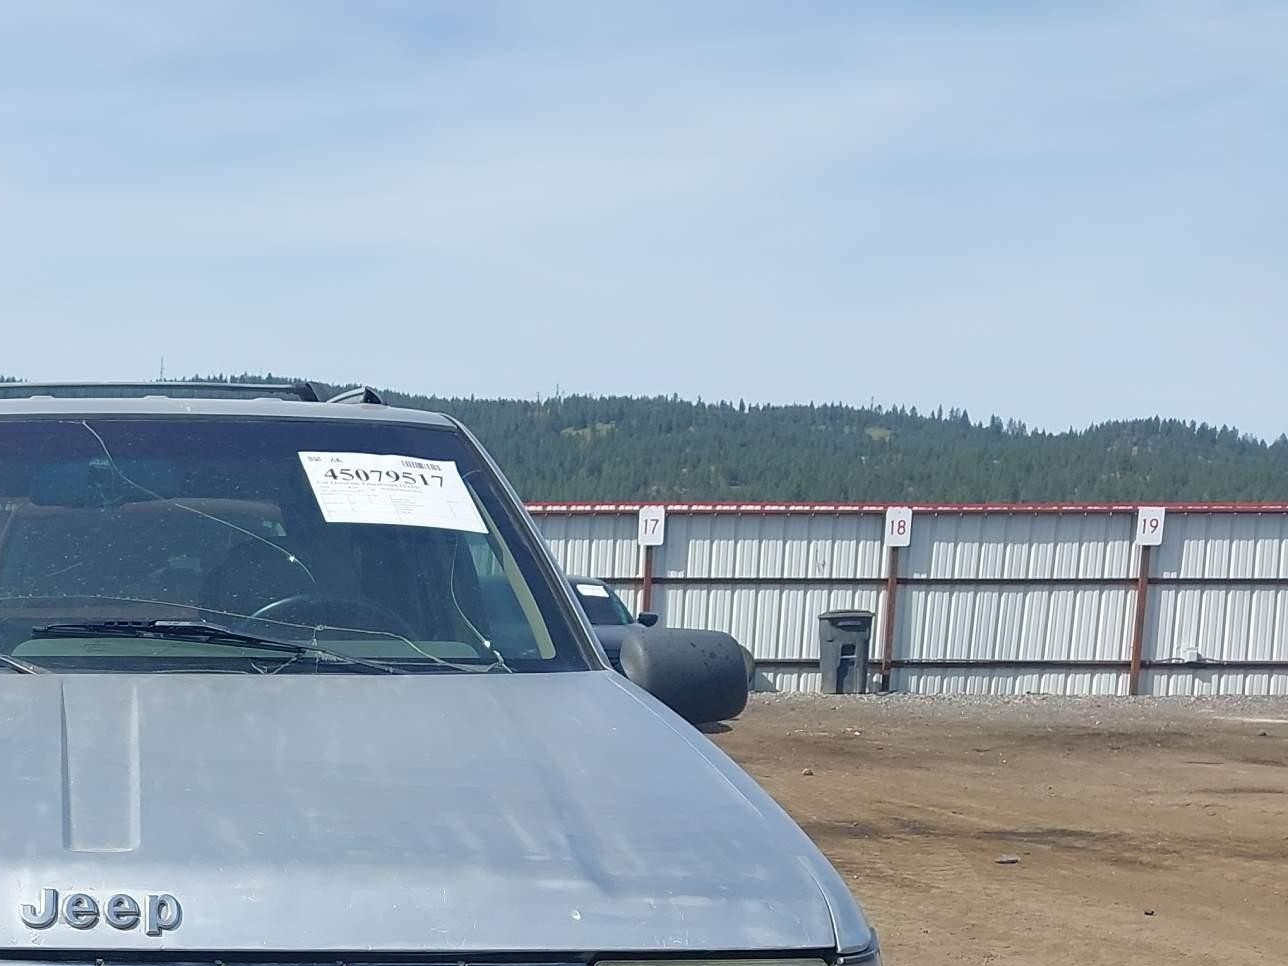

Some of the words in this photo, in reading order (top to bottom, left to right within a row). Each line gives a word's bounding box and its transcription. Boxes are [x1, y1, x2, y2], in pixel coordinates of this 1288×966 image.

[324, 467, 444, 488] 45079517
[644, 518, 660, 535] 17
[890, 519, 906, 536] 18
[1142, 518, 1159, 535] 19
[20, 888, 183, 937] Jeep
